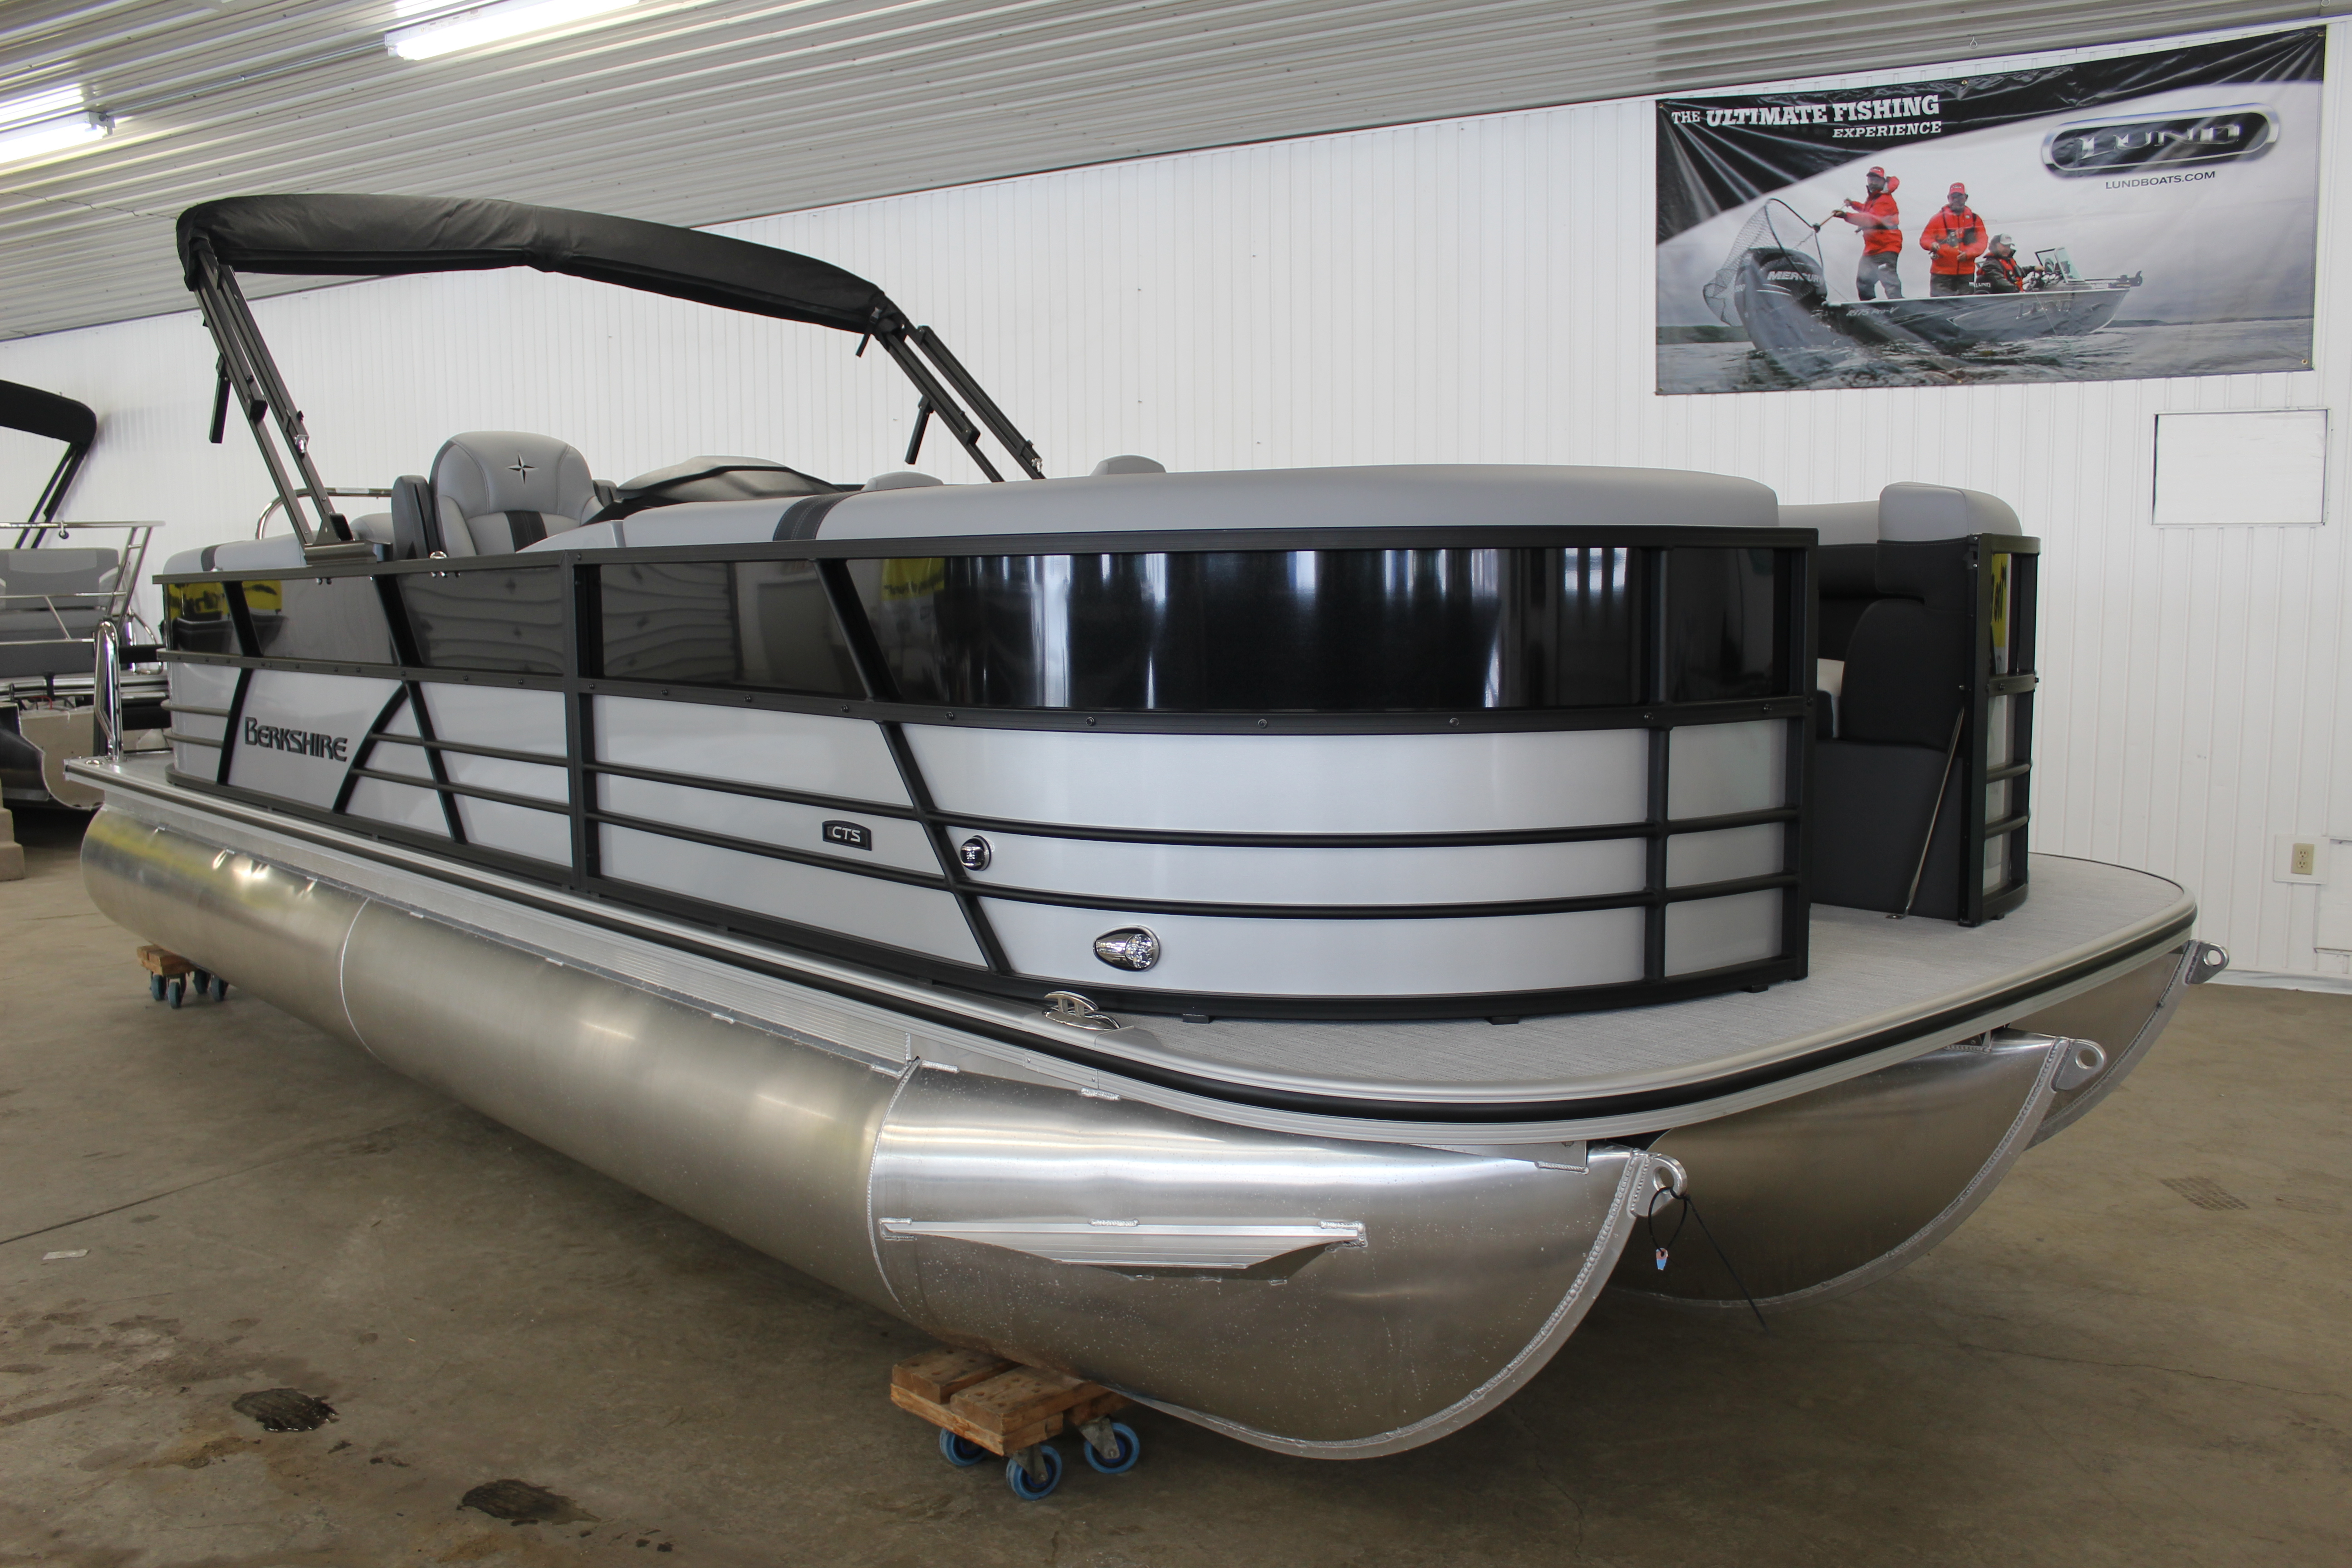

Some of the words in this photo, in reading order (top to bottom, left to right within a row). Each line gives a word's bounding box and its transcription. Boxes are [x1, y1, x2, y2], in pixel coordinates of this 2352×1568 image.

[1671, 111, 1700, 125] THE
[1705, 106, 1828, 127] ULTIMATE
[1832, 94, 1940, 122] FISHING
[1832, 121, 1942, 138] EXPERIENCE
[2105, 171, 2216, 190] LUNDBOATS.COM
[245, 716, 348, 762] BERKSHIRE
[832, 826, 861, 843] CTS
